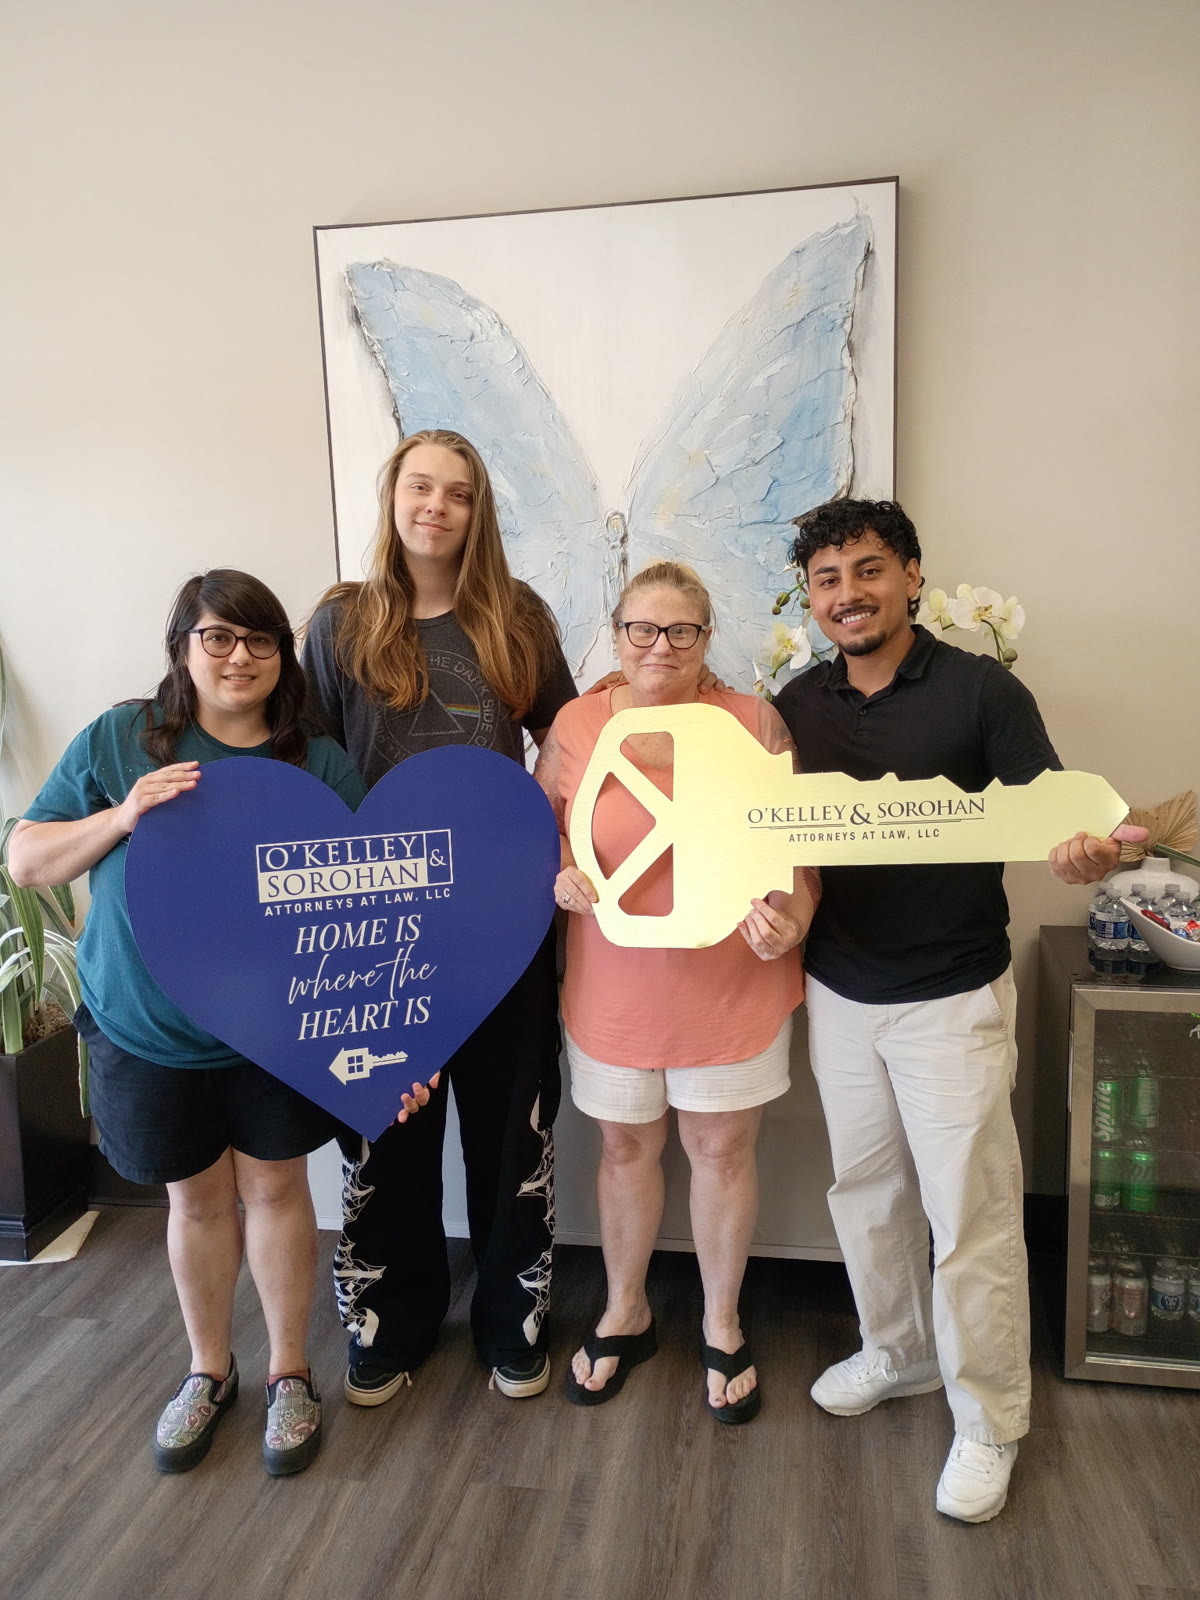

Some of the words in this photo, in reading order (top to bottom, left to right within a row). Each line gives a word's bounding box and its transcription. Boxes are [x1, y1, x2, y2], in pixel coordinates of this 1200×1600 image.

[425, 654, 452, 669] HE
[453, 661, 491, 697] DARK
[481, 699, 495, 734] SIDE
[747, 804, 847, 824] O'KELLEY
[850, 803, 874, 825] &
[877, 798, 985, 818] SOROHAN
[265, 835, 418, 870] O'KELLEY
[429, 849, 447, 867] &
[789, 832, 856, 843] ATTORNEYS
[862, 831, 876, 840] AT
[882, 830, 910, 840] LAW,
[918, 829, 940, 838] LLC
[267, 862, 420, 898] SOROHAN
[264, 898, 353, 917] ATTORNEYS
[360, 895, 377, 907] AT
[385, 891, 419, 904] LAW,
[425, 888, 451, 899] LLC
[294, 918, 388, 955] HOME
[394, 914, 422, 943] IS
[288, 953, 383, 1005] where
[375, 944, 437, 1000] the
[297, 1000, 398, 1041] HEART
[403, 995, 431, 1026] IS
